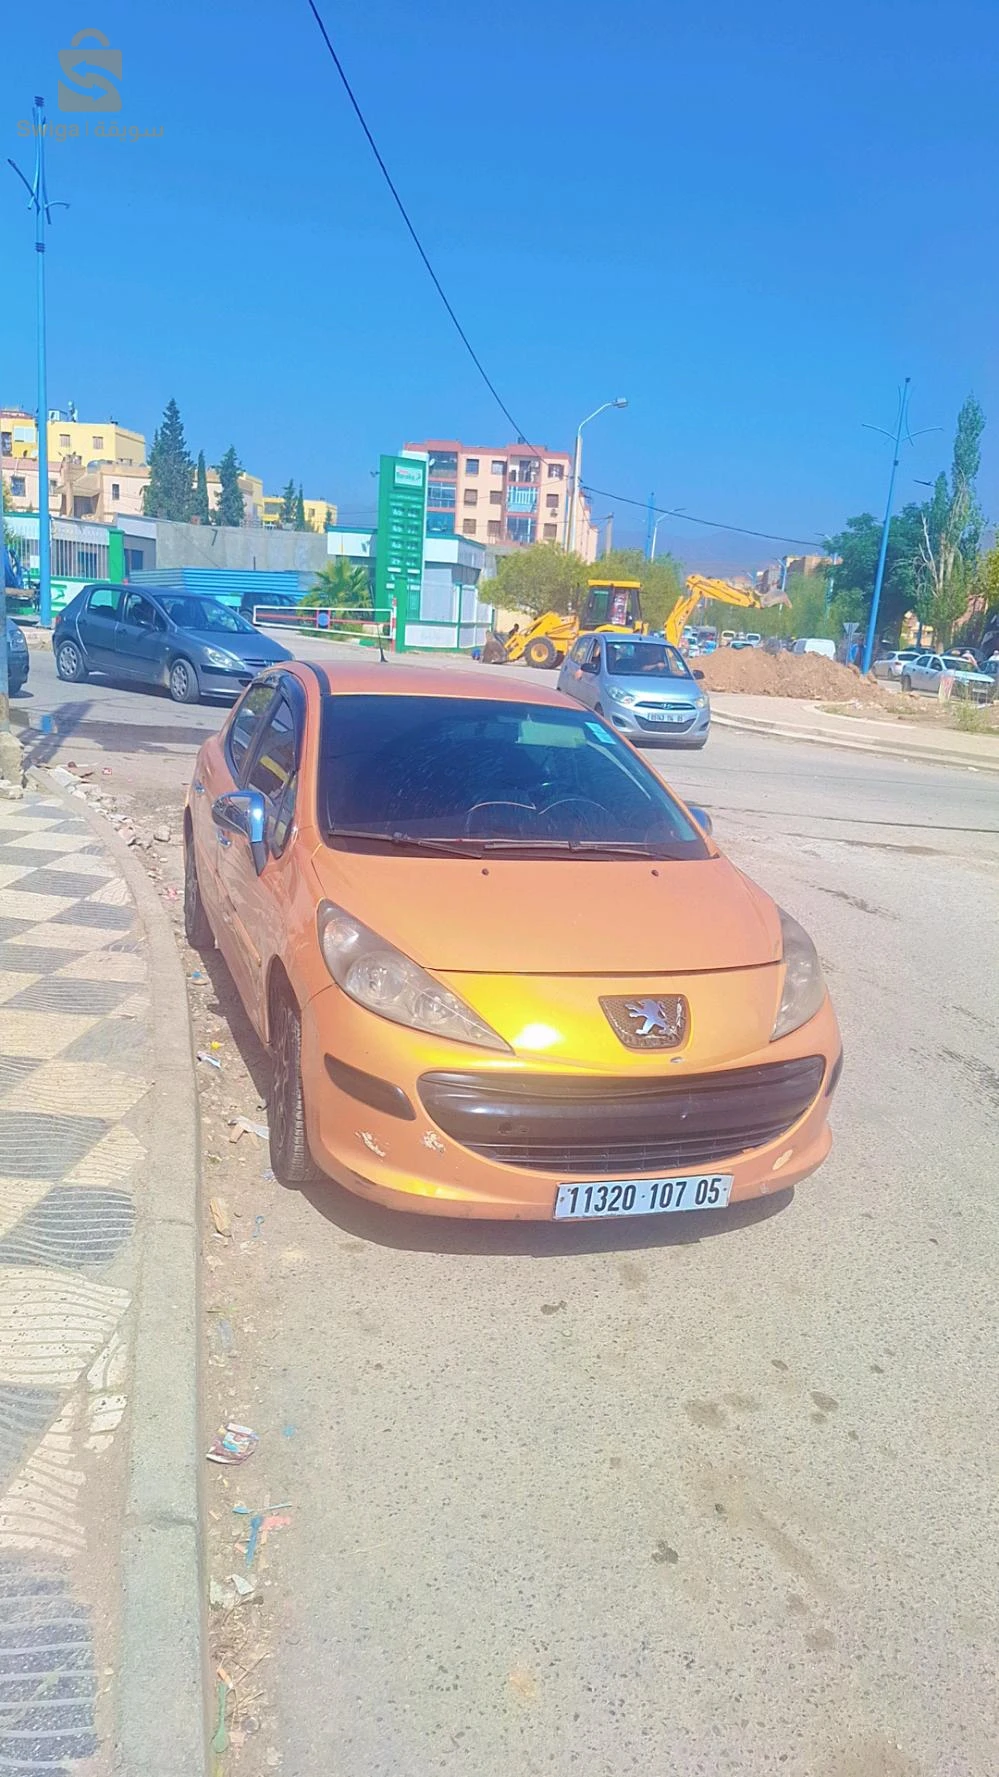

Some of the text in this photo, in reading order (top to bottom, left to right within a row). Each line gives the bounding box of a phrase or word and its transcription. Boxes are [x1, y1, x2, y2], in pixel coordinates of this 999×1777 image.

[569, 1177, 722, 1214] 11320 107 05
